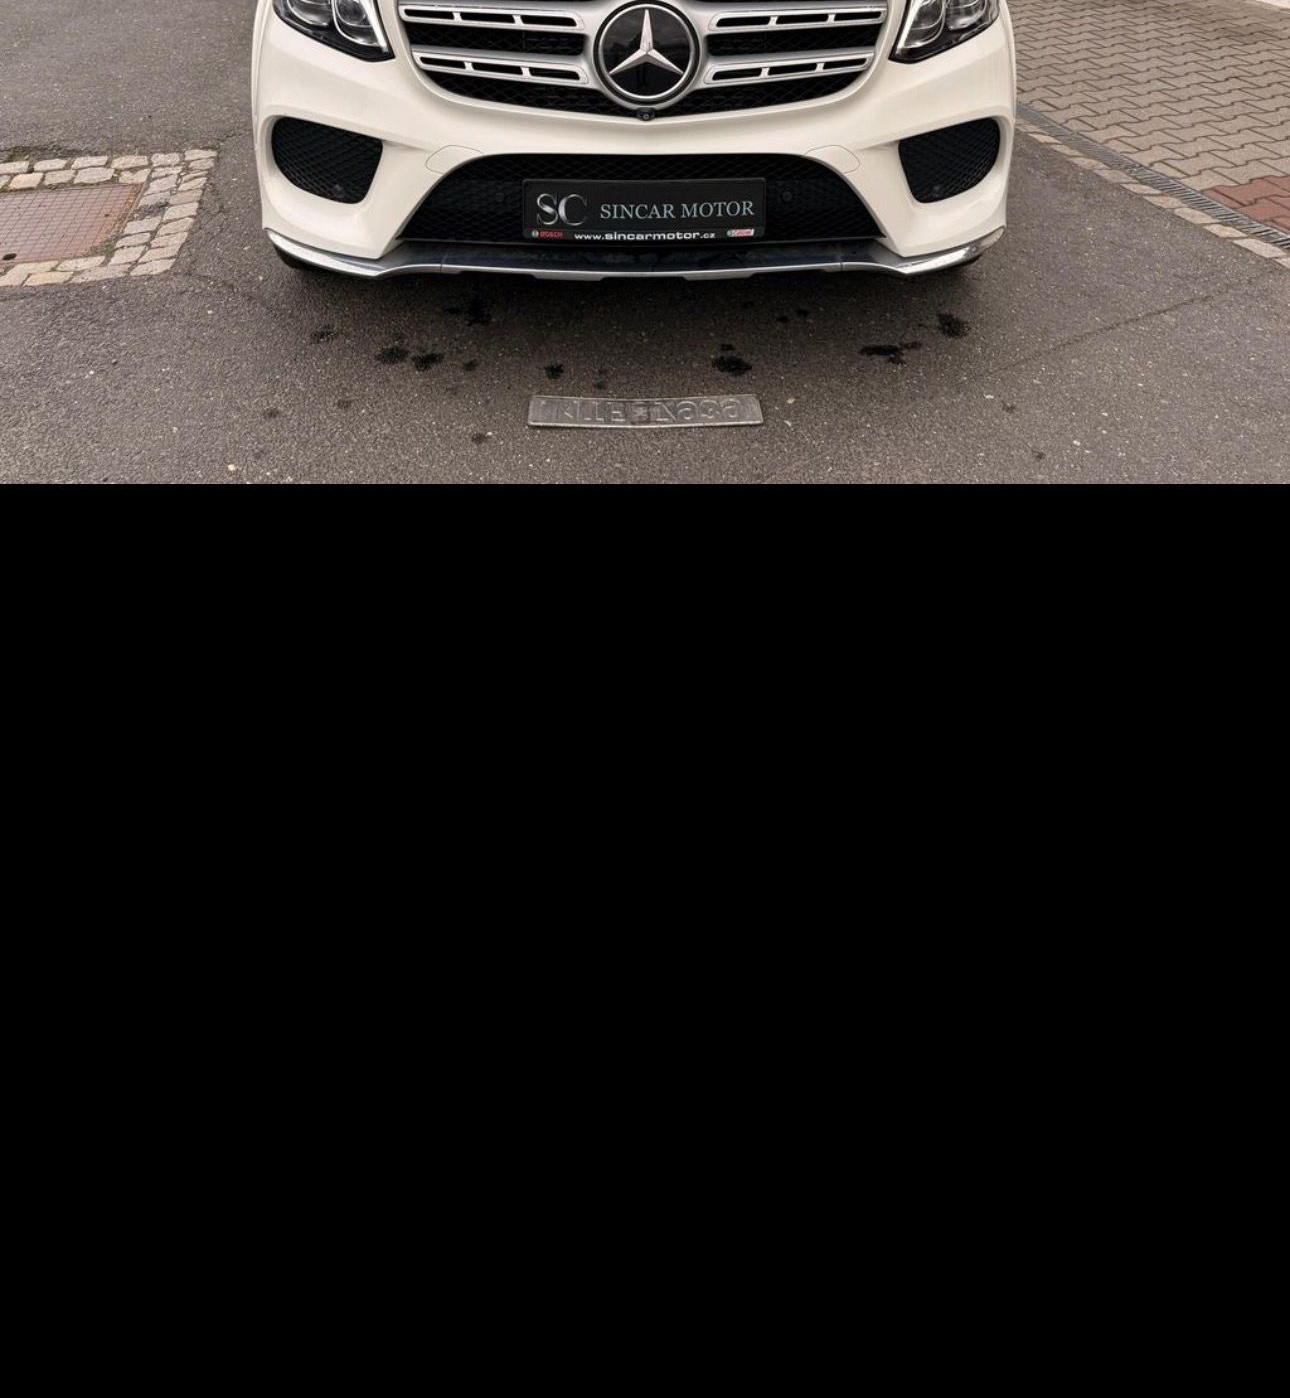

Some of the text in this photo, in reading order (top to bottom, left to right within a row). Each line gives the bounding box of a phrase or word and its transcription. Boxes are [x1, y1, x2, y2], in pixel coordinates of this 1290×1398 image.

[536, 193, 588, 226] SC
[600, 201, 755, 219] SINCAR MOTOR
[574, 231, 716, 240] www.sincarmotor.cz
